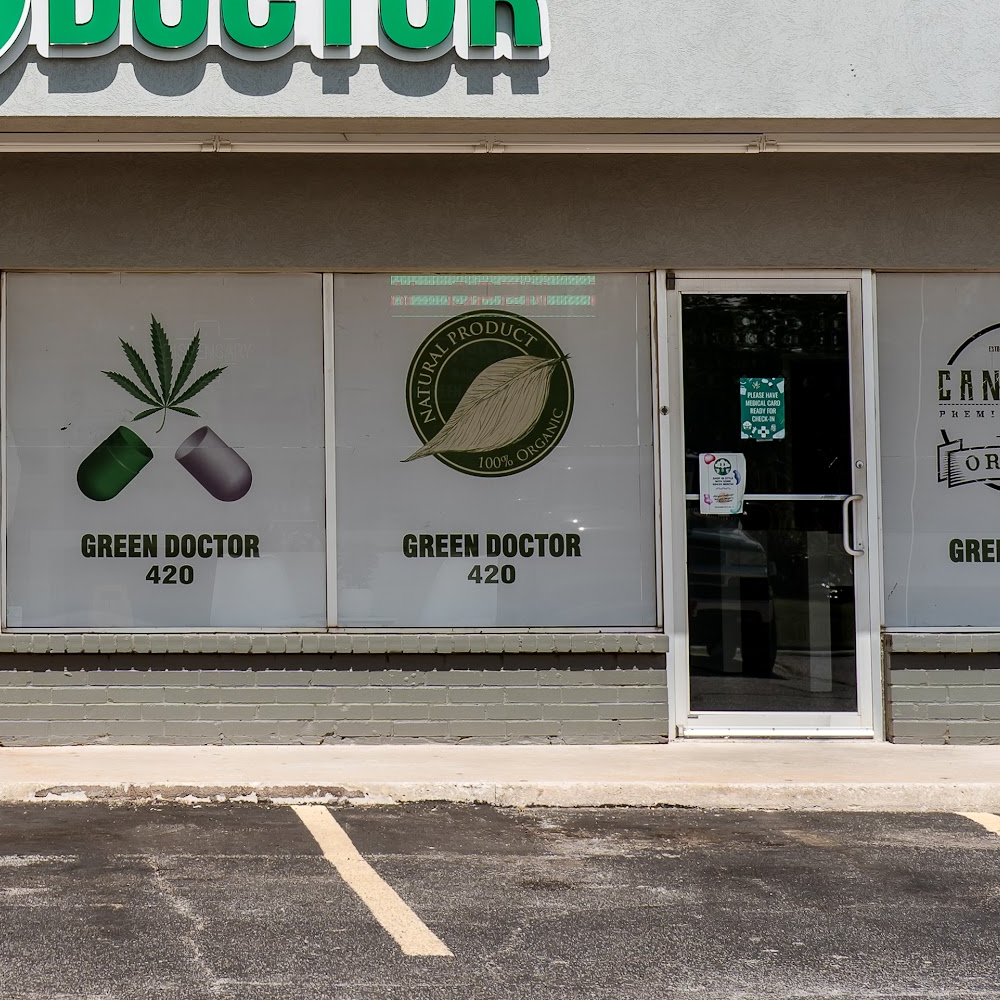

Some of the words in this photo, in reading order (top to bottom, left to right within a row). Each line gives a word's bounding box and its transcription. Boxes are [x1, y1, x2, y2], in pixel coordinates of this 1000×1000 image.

[417, 342, 450, 424] NATURAL
[446, 320, 538, 348] PRODUCT
[478, 455, 514, 469] 100%
[516, 407, 564, 462] ORGANIC
[81, 534, 158, 559] GREEN
[165, 534, 260, 559] DOCTOR
[402, 533, 479, 558] GREEN
[486, 533, 581, 558] DOCTOR
[145, 565, 194, 585] 420
[467, 564, 516, 584] 420
